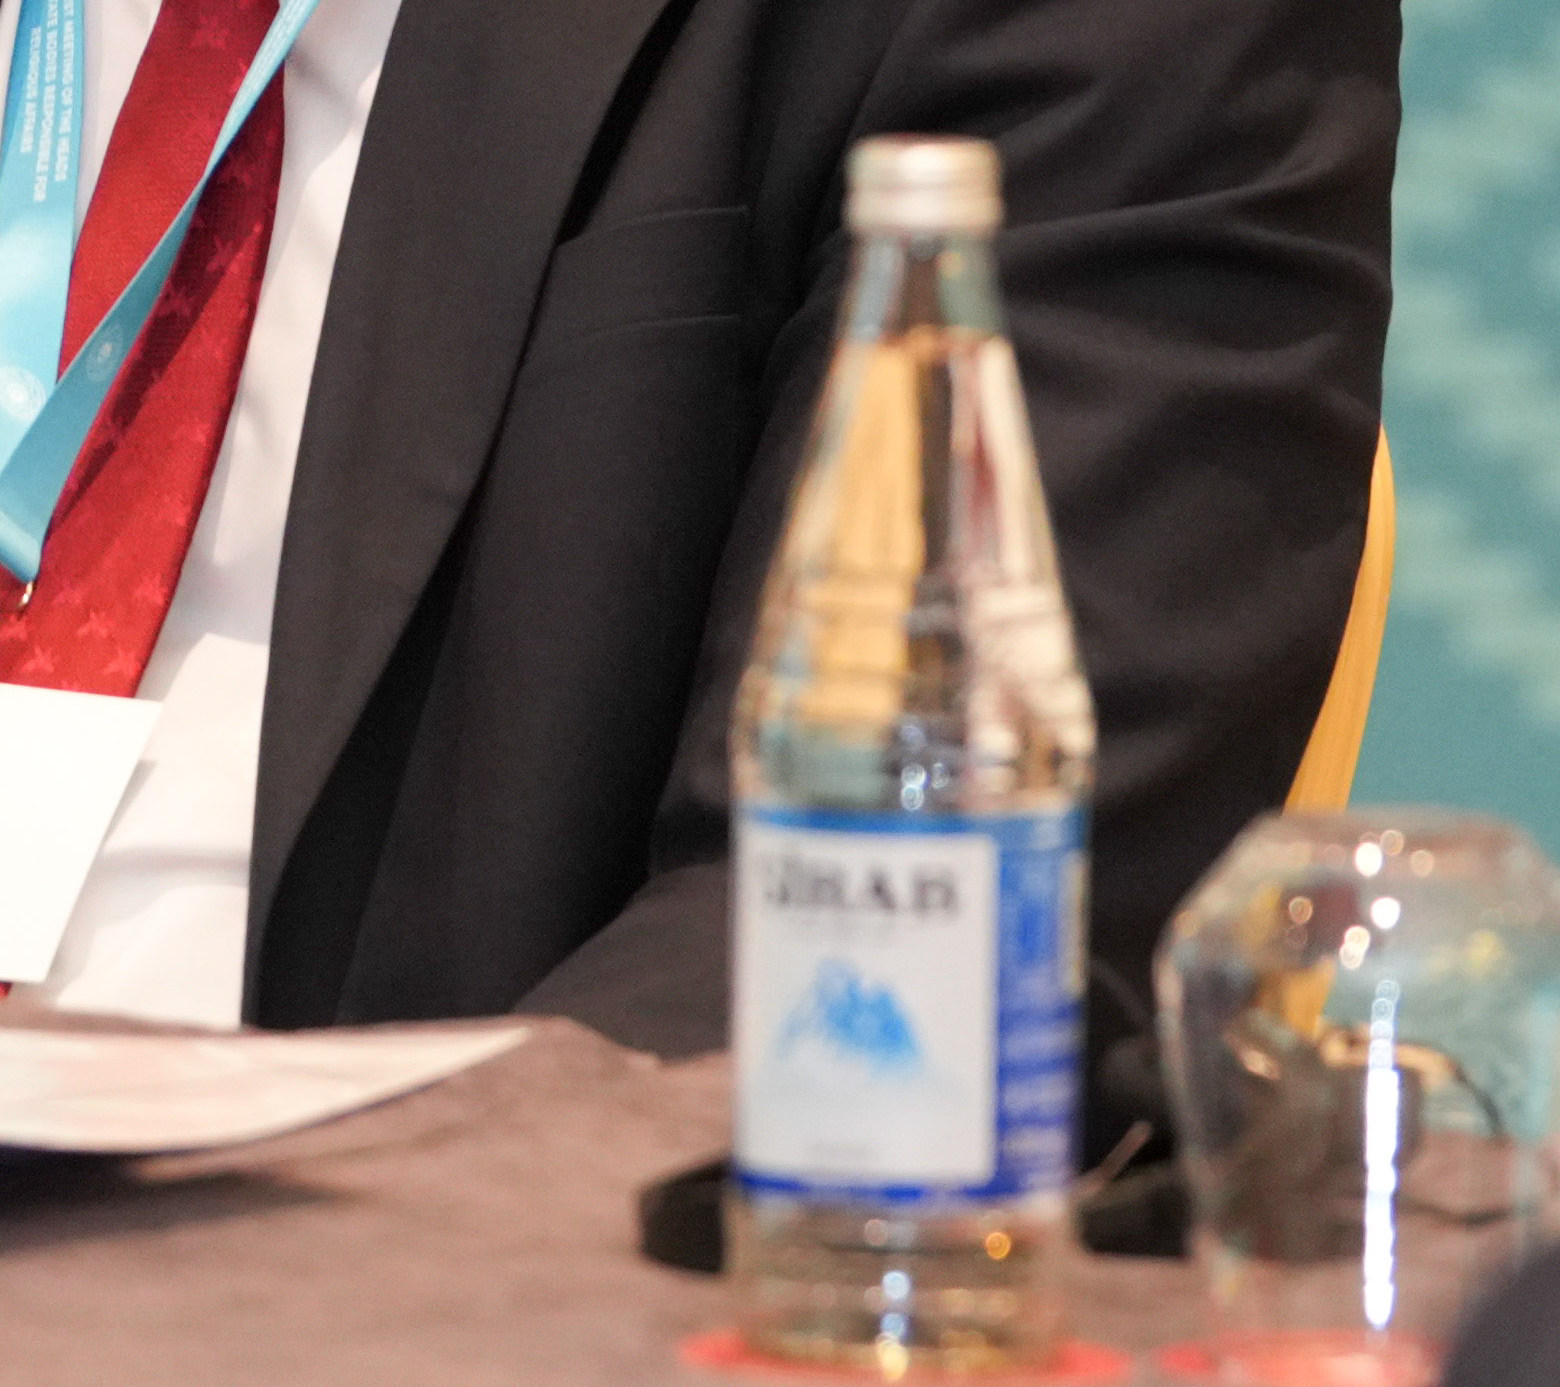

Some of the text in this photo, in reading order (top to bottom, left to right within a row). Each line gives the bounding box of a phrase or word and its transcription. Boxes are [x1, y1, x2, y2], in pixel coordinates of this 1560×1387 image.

[45, 29, 58, 83] BODIES
[62, 20, 74, 85] MEETING
[61, 86, 73, 106] OF
[37, 84, 56, 173] RESPONSIBLE
[54, 136, 70, 182] HEADS
[33, 174, 48, 202] FOR
